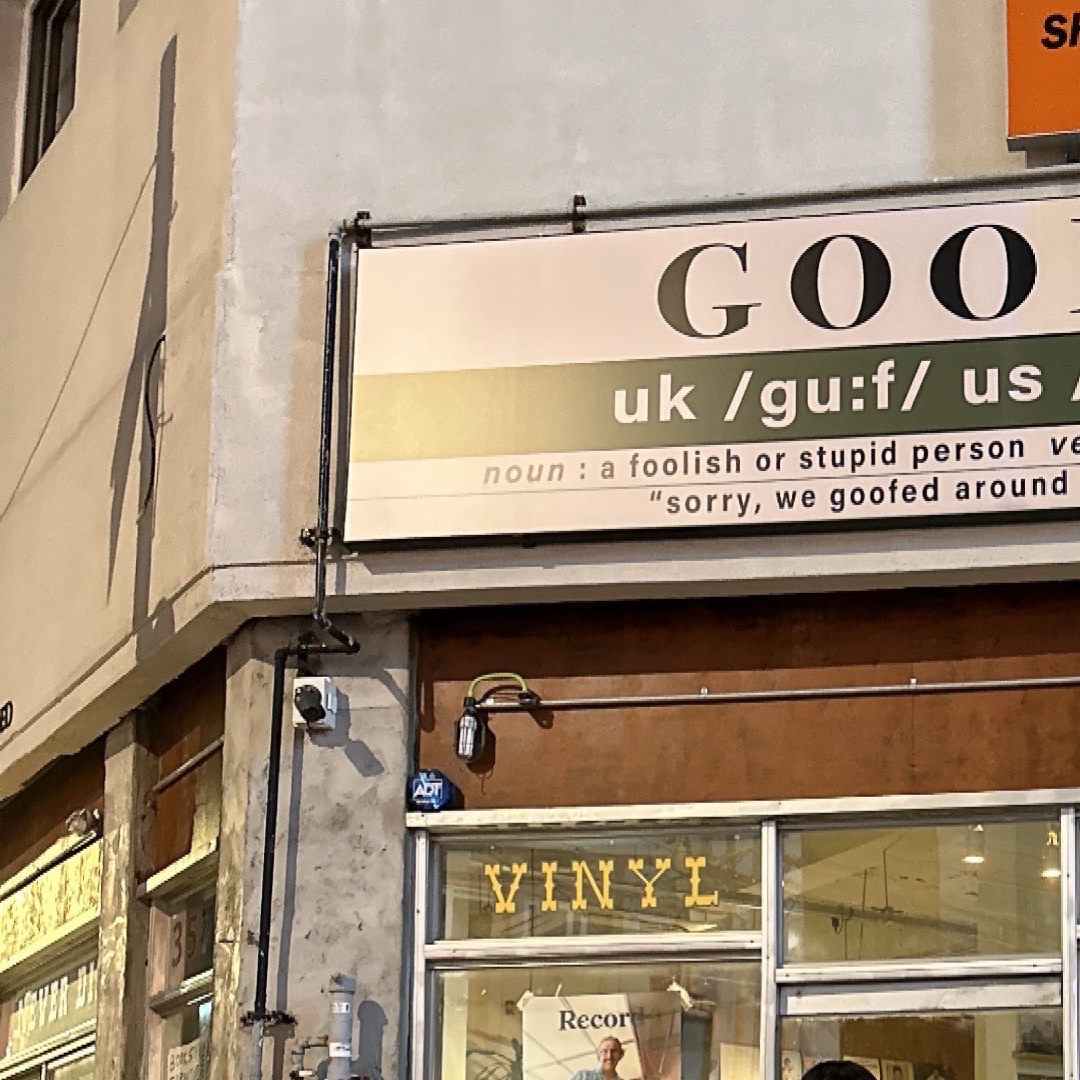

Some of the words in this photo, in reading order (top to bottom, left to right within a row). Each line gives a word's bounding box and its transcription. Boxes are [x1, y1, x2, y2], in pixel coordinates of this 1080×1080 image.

[613, 373, 697, 424] uk
[723, 359, 932, 429] /gu:f/
[962, 364, 1043, 404] us
[483, 461, 565, 484] noun
[600, 459, 615, 480] a
[629, 449, 741, 478] foolish
[755, 451, 786, 473] or
[799, 439, 897, 473] stupid
[912, 438, 1025, 471] person
[776, 489, 817, 510] we
[829, 477, 940, 513] goofed
[955, 470, 1068, 500] around
[413, 782, 442, 798] ADT
[484, 856, 719, 914] VINYL
